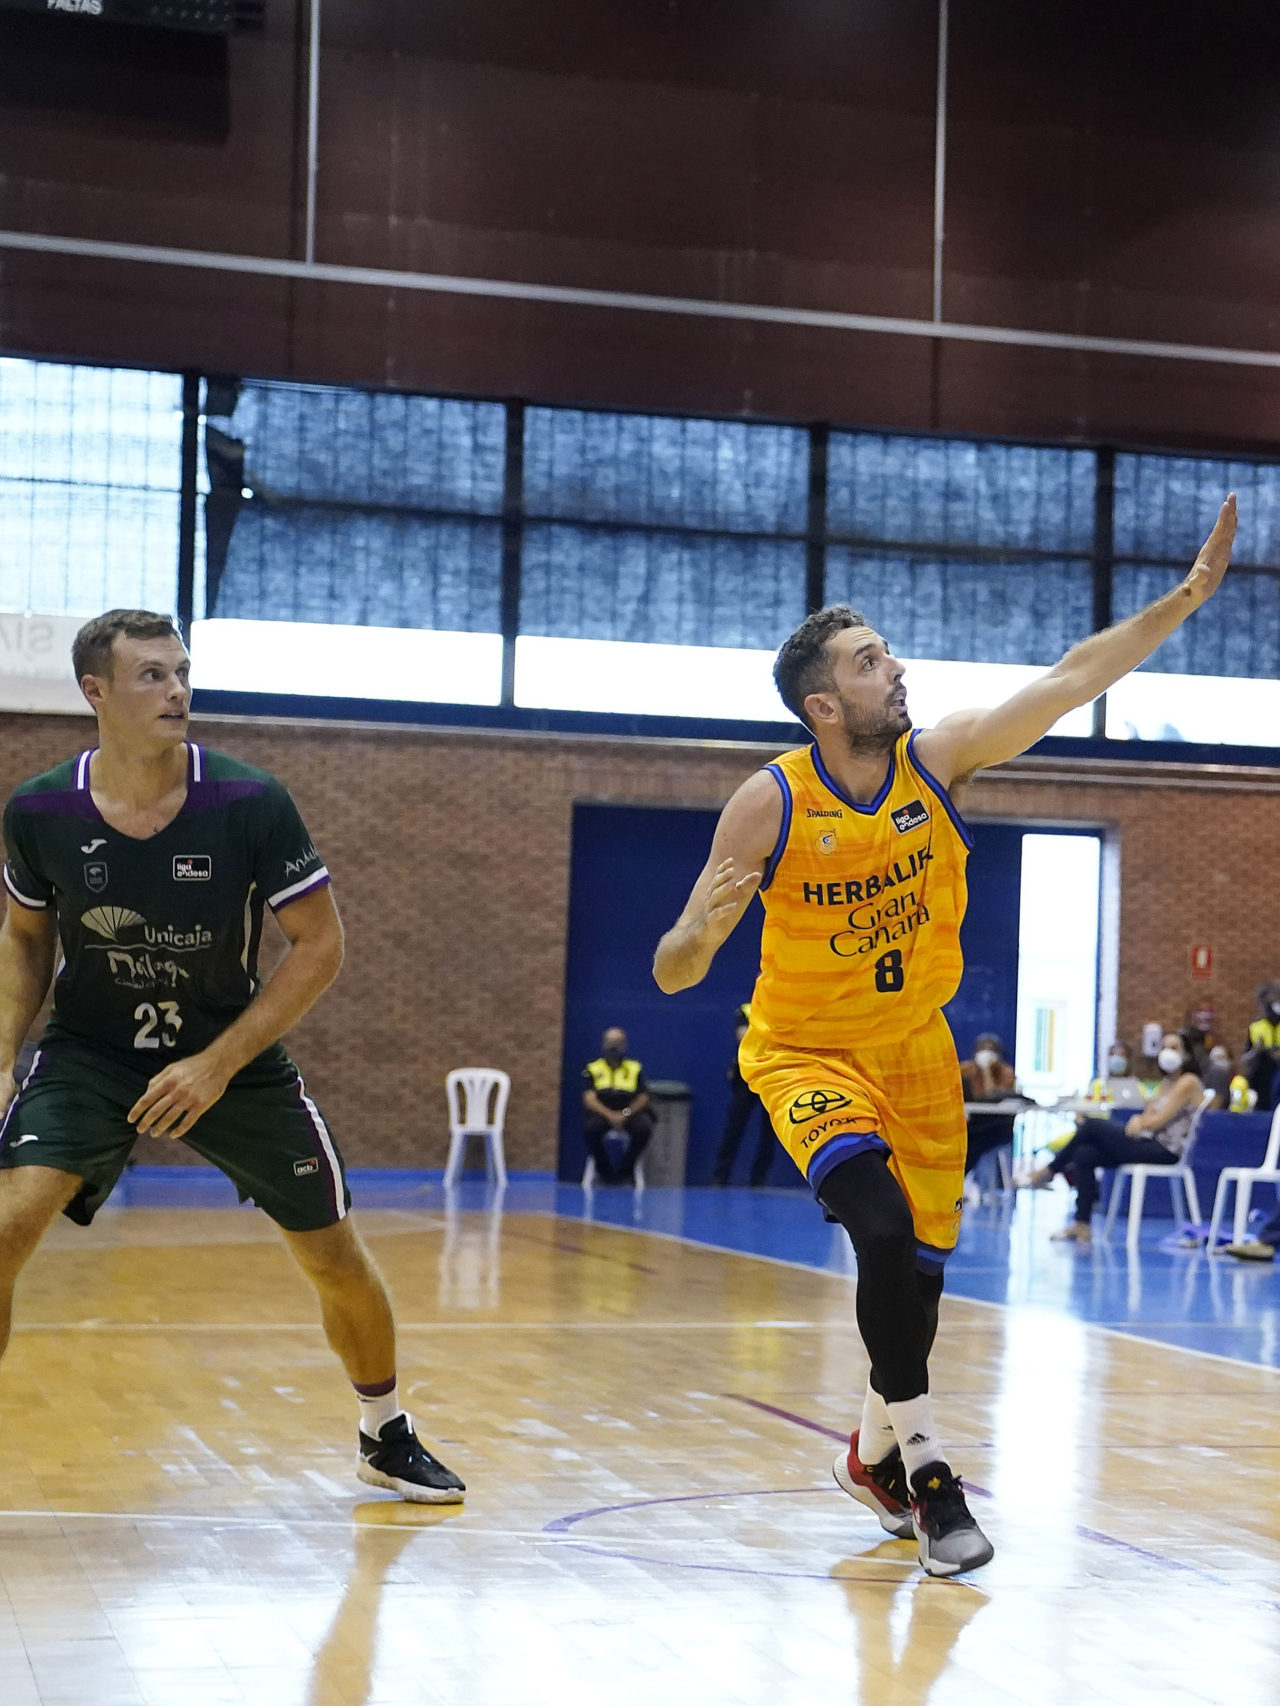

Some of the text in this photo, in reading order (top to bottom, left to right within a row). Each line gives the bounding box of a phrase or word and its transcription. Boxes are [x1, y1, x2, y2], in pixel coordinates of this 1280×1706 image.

[806, 808, 843, 819] SPALDING
[895, 813, 911, 826] liga
[847, 891, 917, 930] Gran
[144, 924, 213, 948] Unicaja
[874, 948, 905, 993] 8
[133, 1000, 183, 1049] 23
